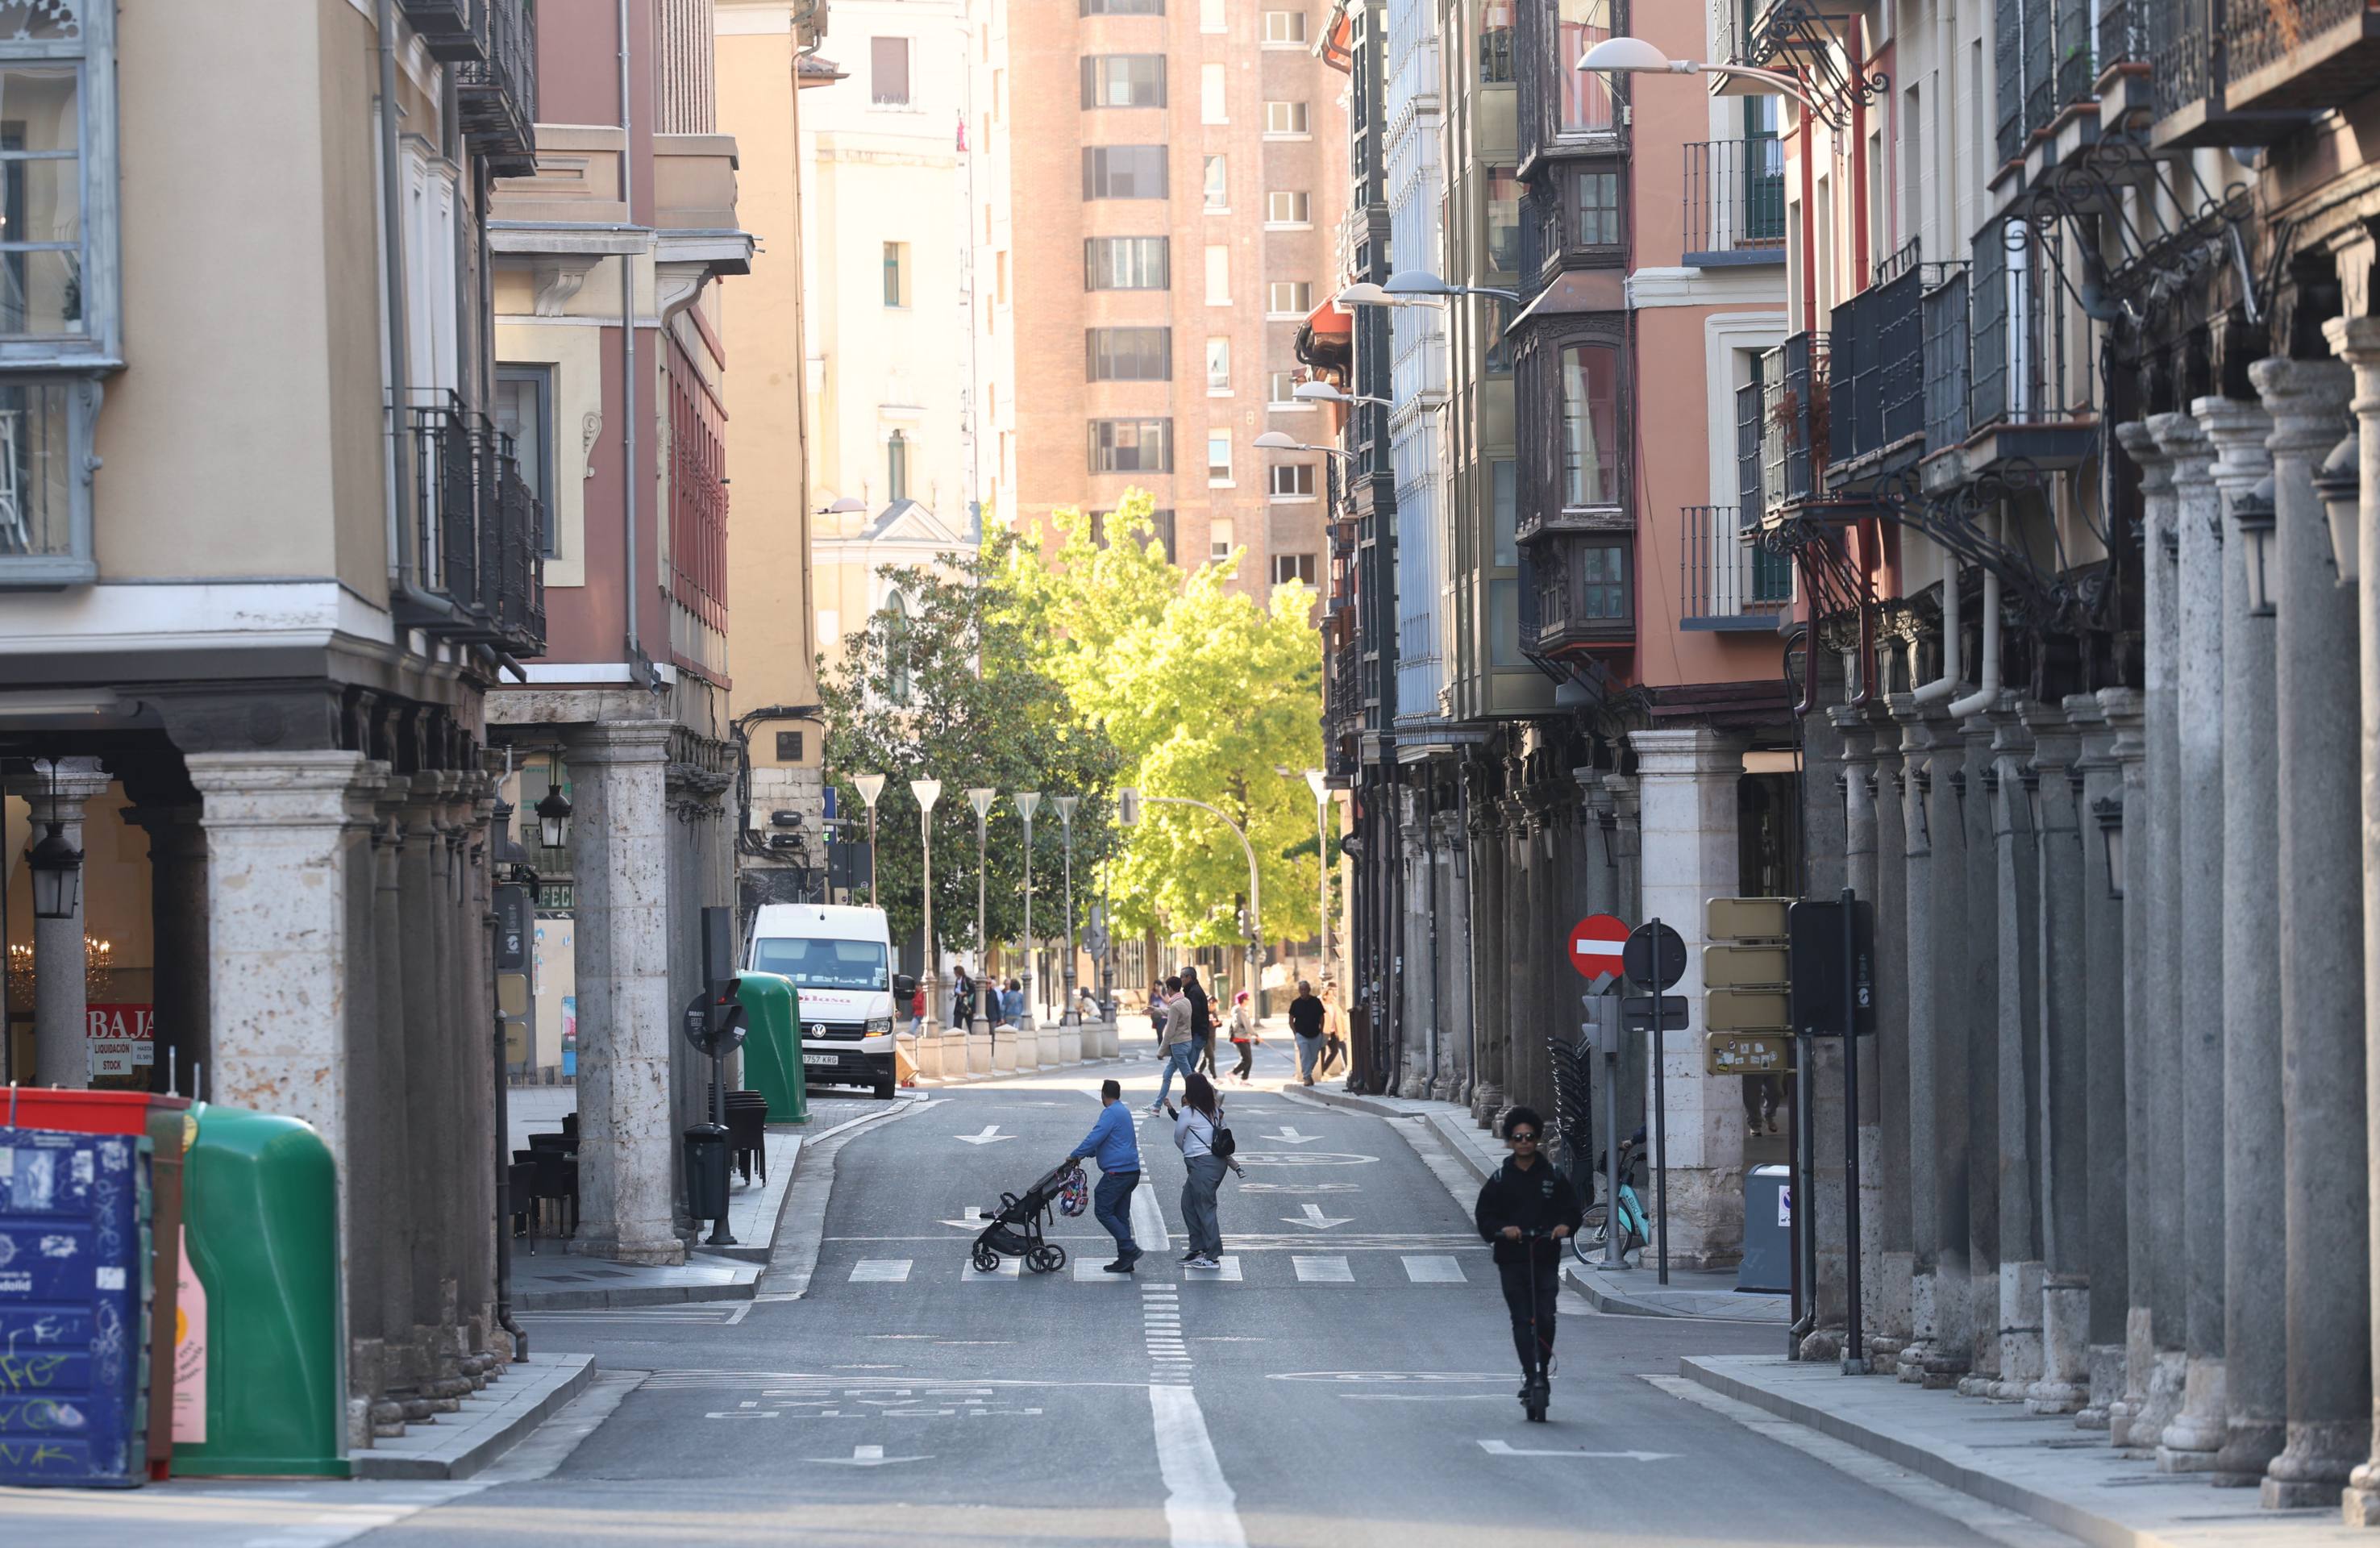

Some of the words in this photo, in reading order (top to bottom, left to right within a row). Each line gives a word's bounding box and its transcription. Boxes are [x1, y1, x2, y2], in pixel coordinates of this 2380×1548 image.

[94, 1042, 130, 1054] LIQUIDACIÓN
[103, 1060, 122, 1071] STOCK
[822, 1056, 837, 1064] KRG
